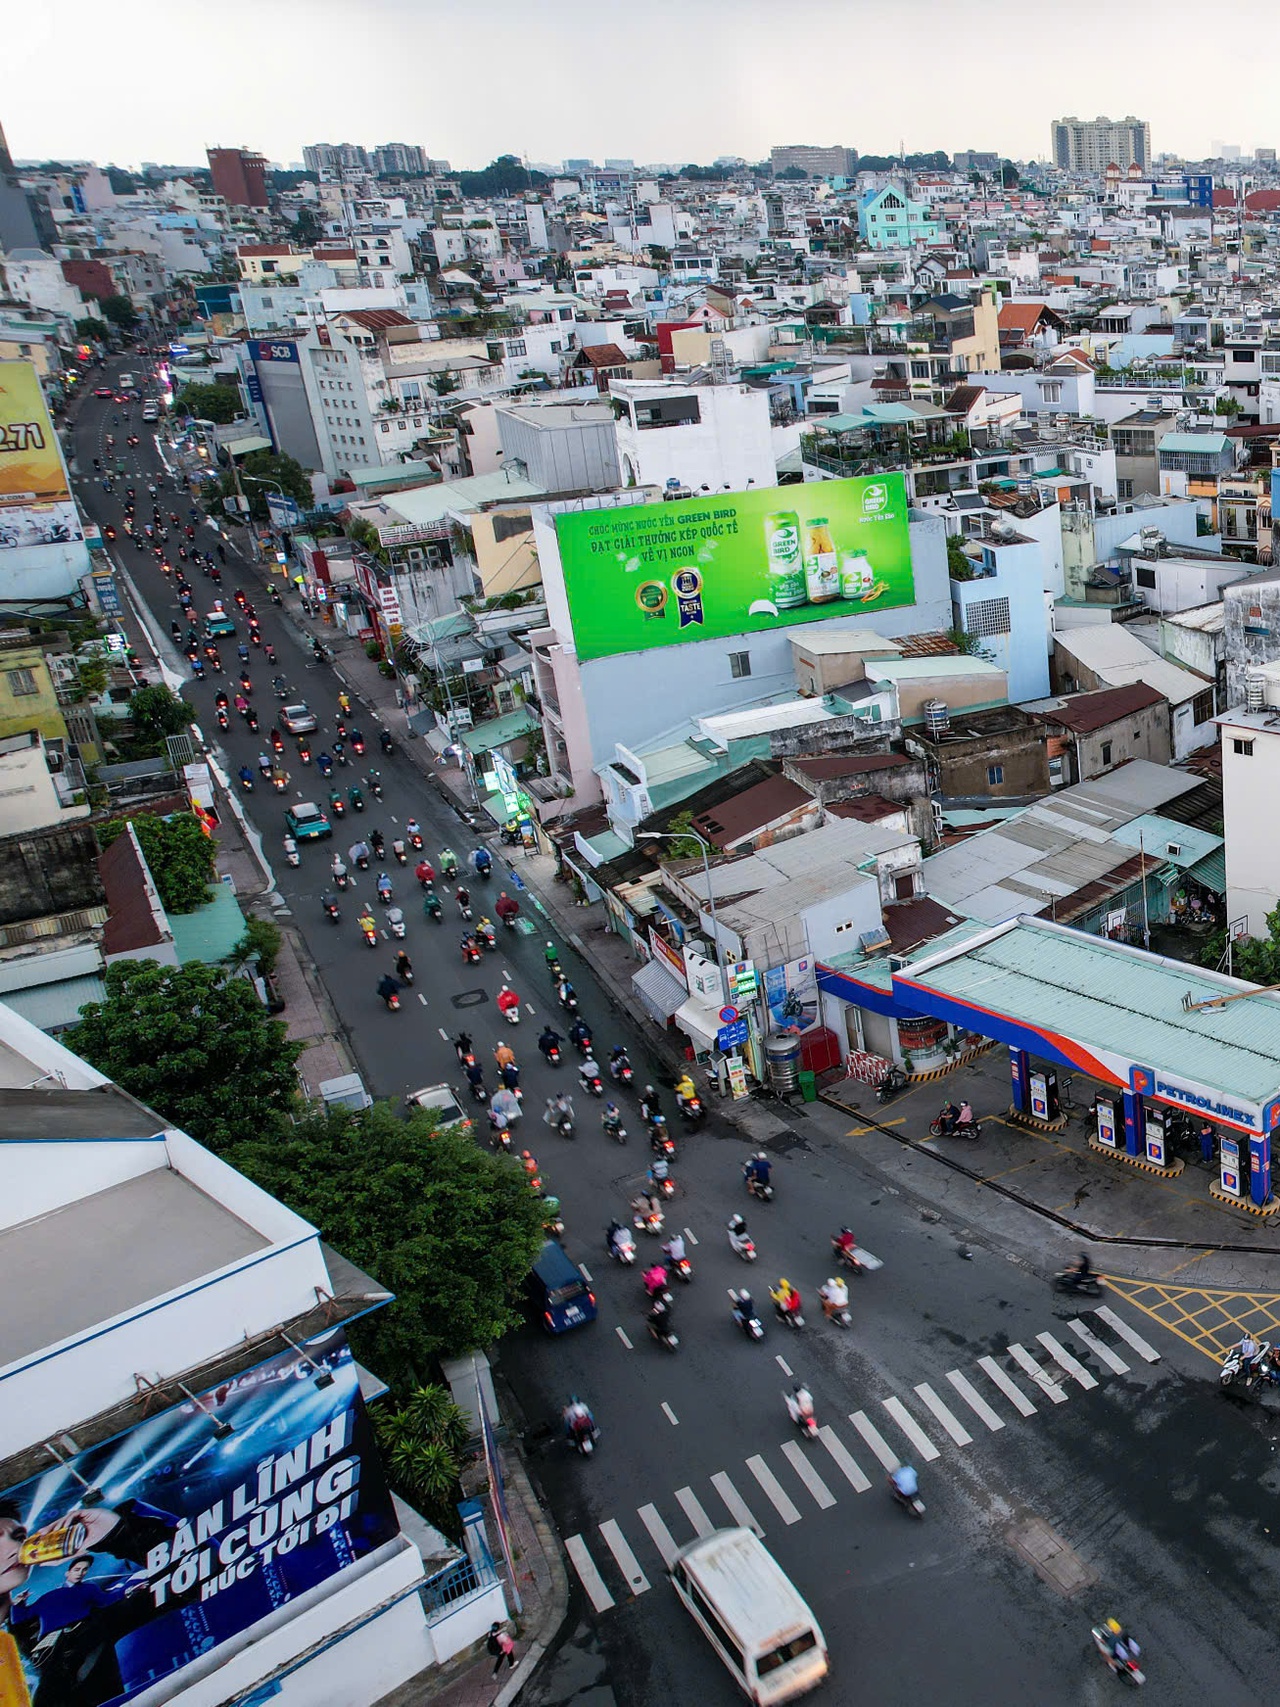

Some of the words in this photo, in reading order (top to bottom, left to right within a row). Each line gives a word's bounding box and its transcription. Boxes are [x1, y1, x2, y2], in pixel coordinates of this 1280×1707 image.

[270, 345, 292, 359] SCB
[677, 511, 711, 525] GREEN
[713, 508, 737, 520] BIRD
[591, 540, 611, 555] ĐẠT
[614, 535, 636, 550] GIẢI
[638, 529, 678, 548] THƯỞNG
[679, 527, 698, 542] KÉP
[700, 522, 725, 538] QUỐC
[726, 518, 739, 534] TẾ
[772, 539, 796, 548] GREEN
[657, 551, 668, 563] VỊ
[670, 545, 695, 558] NGON
[680, 602, 702, 612] TASTE
[1156, 1081, 1256, 1128] PETROLIMEX
[147, 1500, 224, 1579] BẢN
[232, 1410, 350, 1522] LĨNH
[150, 1547, 212, 1608] TỚI
[218, 1458, 355, 1566] CÙNG
[201, 1557, 258, 1602] HÚC
[260, 1518, 311, 1567] TỚI
[314, 1496, 352, 1536] ĐI
